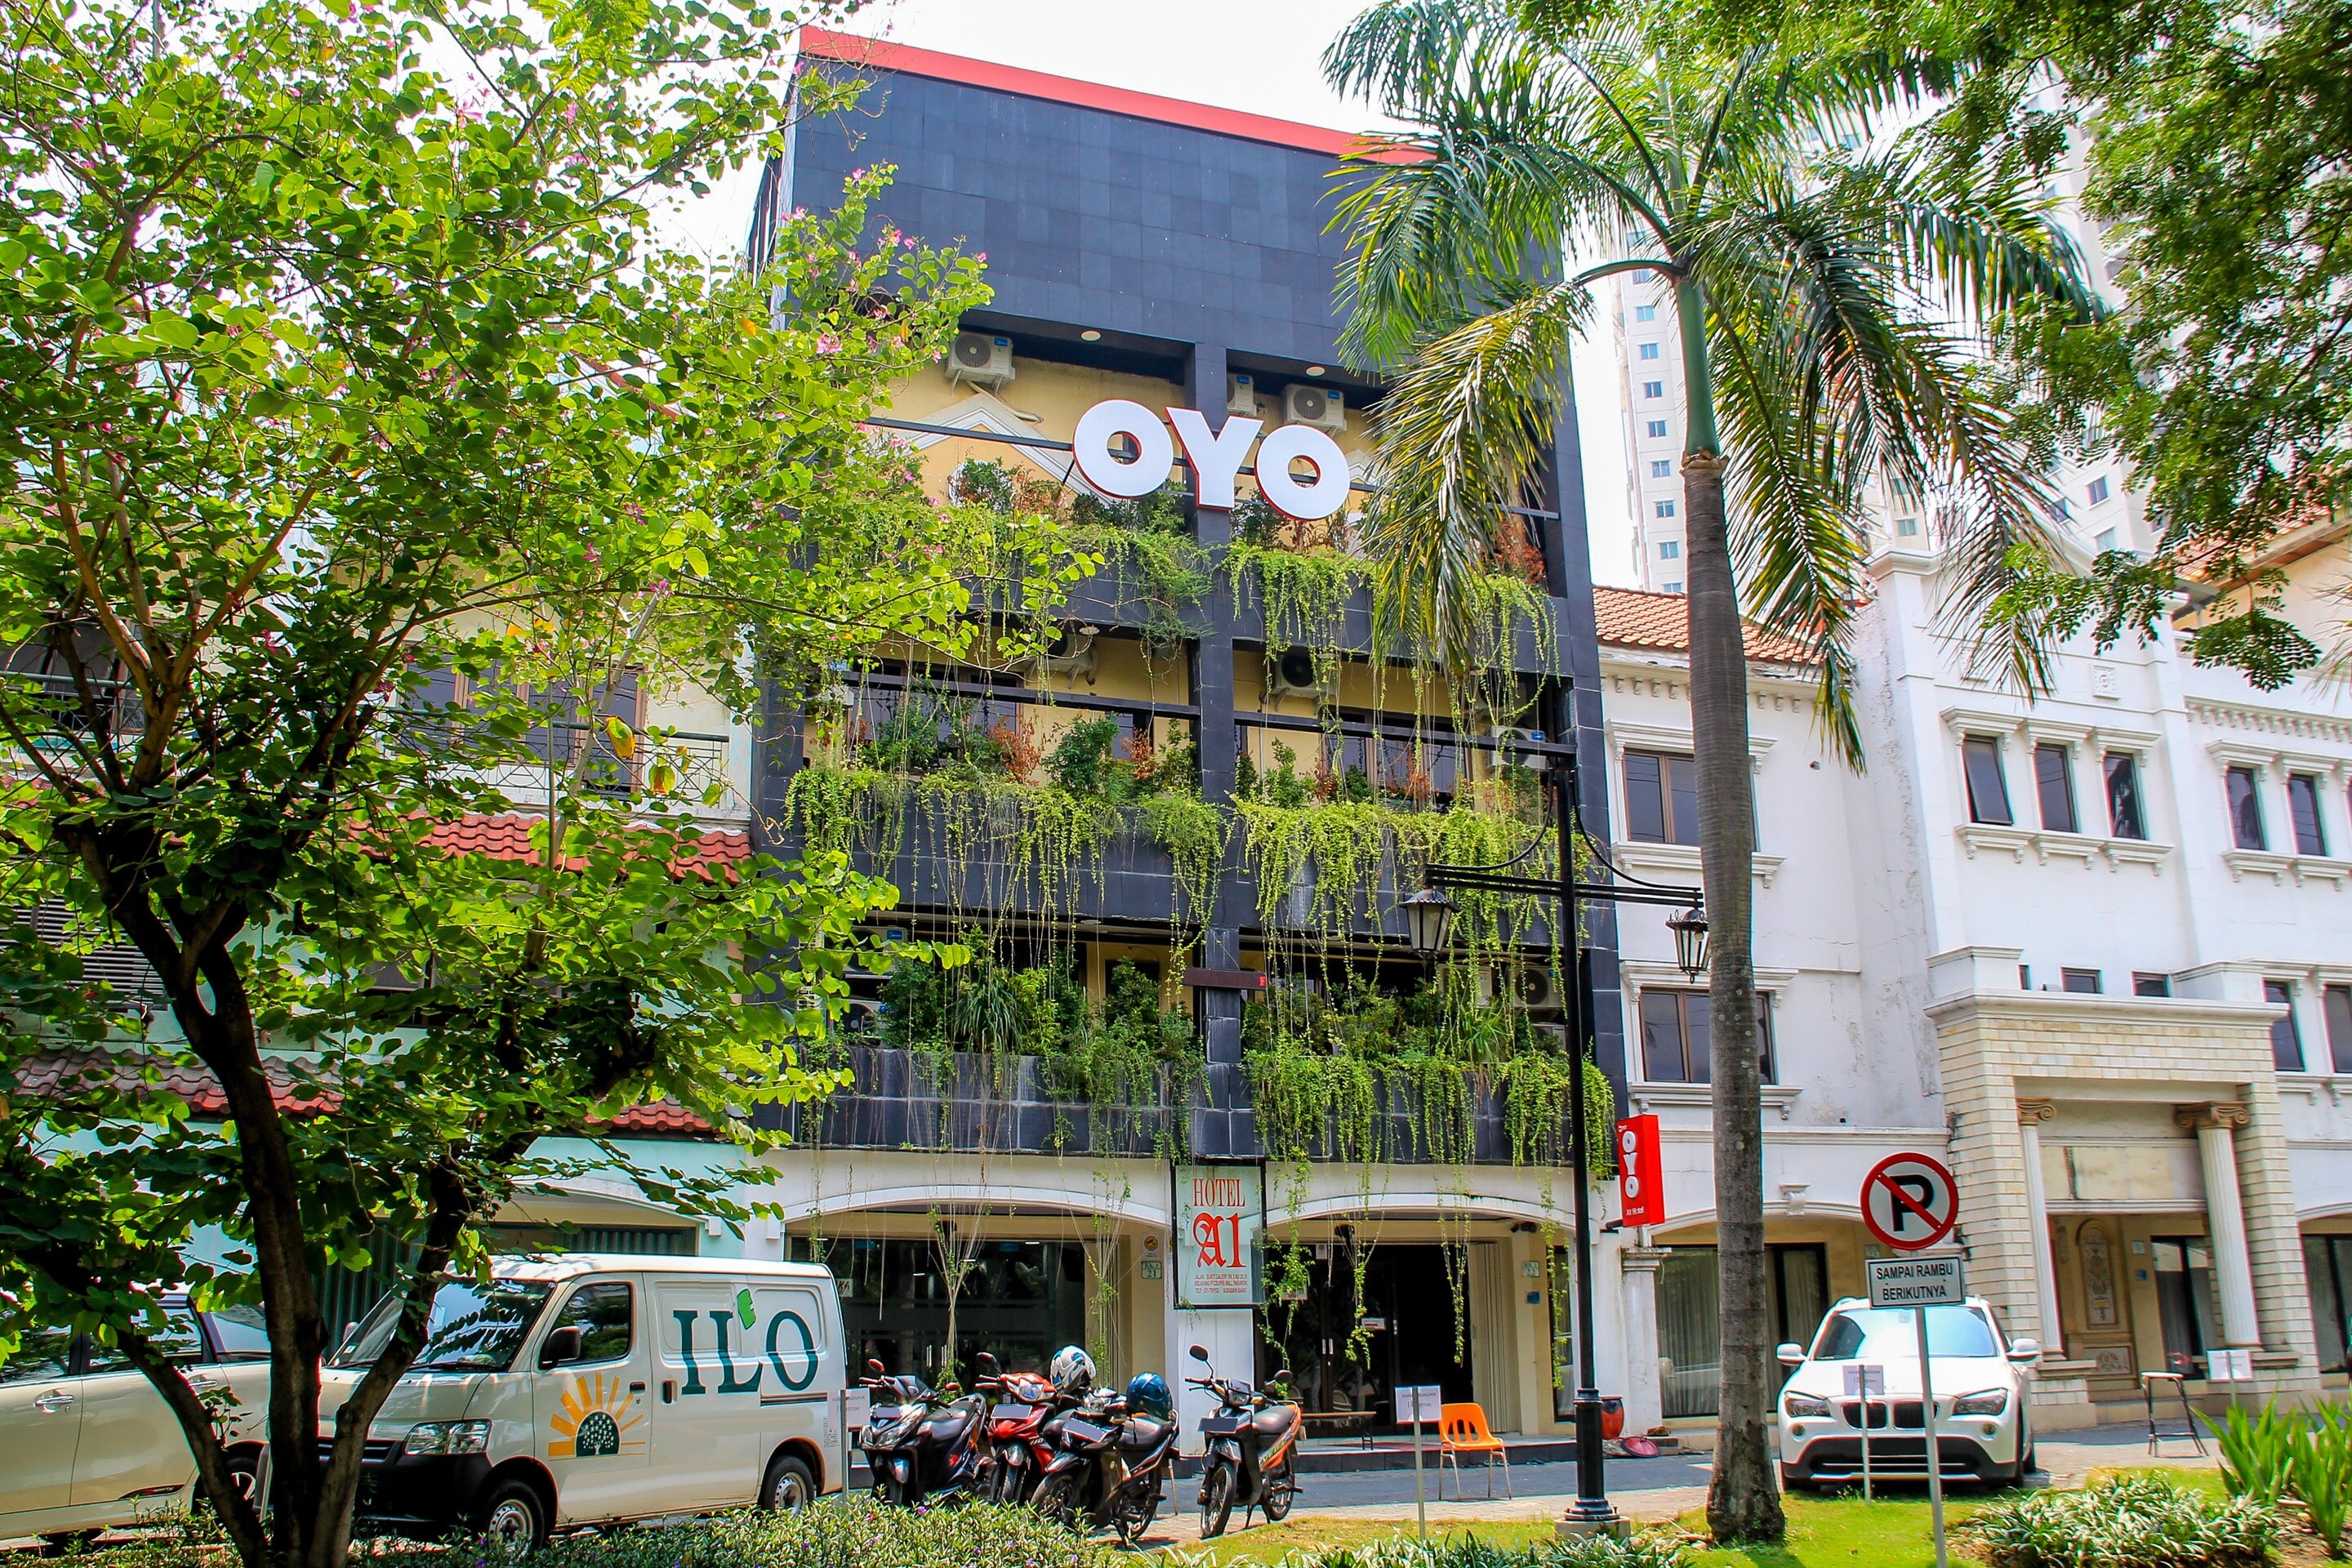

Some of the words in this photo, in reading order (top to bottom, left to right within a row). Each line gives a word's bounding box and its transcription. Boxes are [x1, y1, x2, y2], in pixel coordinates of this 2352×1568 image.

[1073, 399, 1351, 521] OYO
[1622, 1130, 1640, 1199] OYO
[1192, 1178, 1245, 1207] HOTEL
[1147, 1269, 1156, 1277] 21
[1876, 1266, 1913, 1280] SAMPAI
[1917, 1263, 1953, 1276] RAMBU
[1882, 1285, 1946, 1301] BERIKUTNYA
[673, 1310, 818, 1395] ILO
